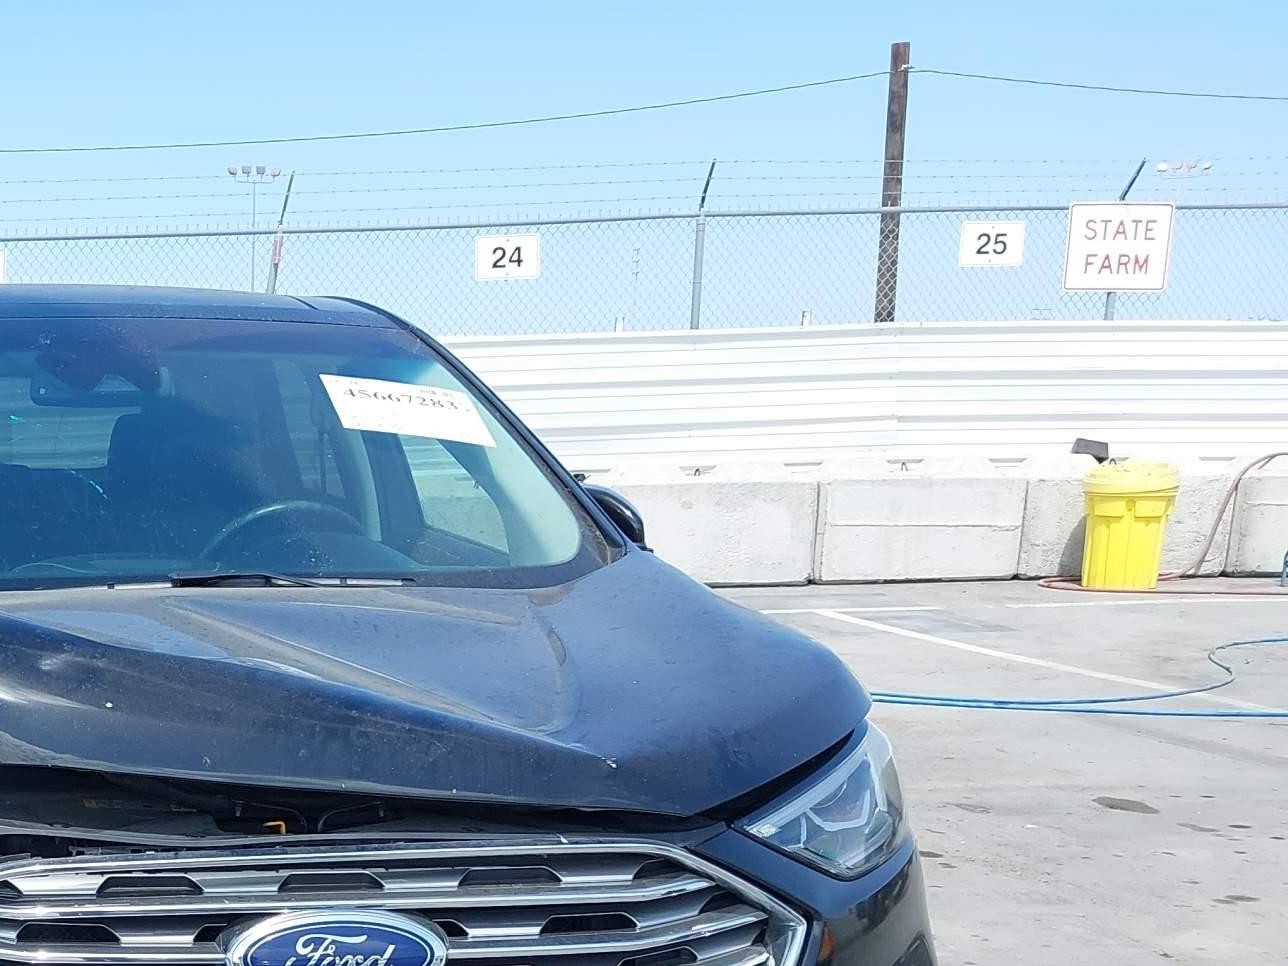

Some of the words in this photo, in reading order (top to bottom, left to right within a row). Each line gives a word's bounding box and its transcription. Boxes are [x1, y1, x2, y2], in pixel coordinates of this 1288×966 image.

[1084, 219, 1157, 241] STATE
[975, 233, 1008, 255] 25
[492, 246, 524, 269] 24
[1083, 253, 1150, 275] FARM
